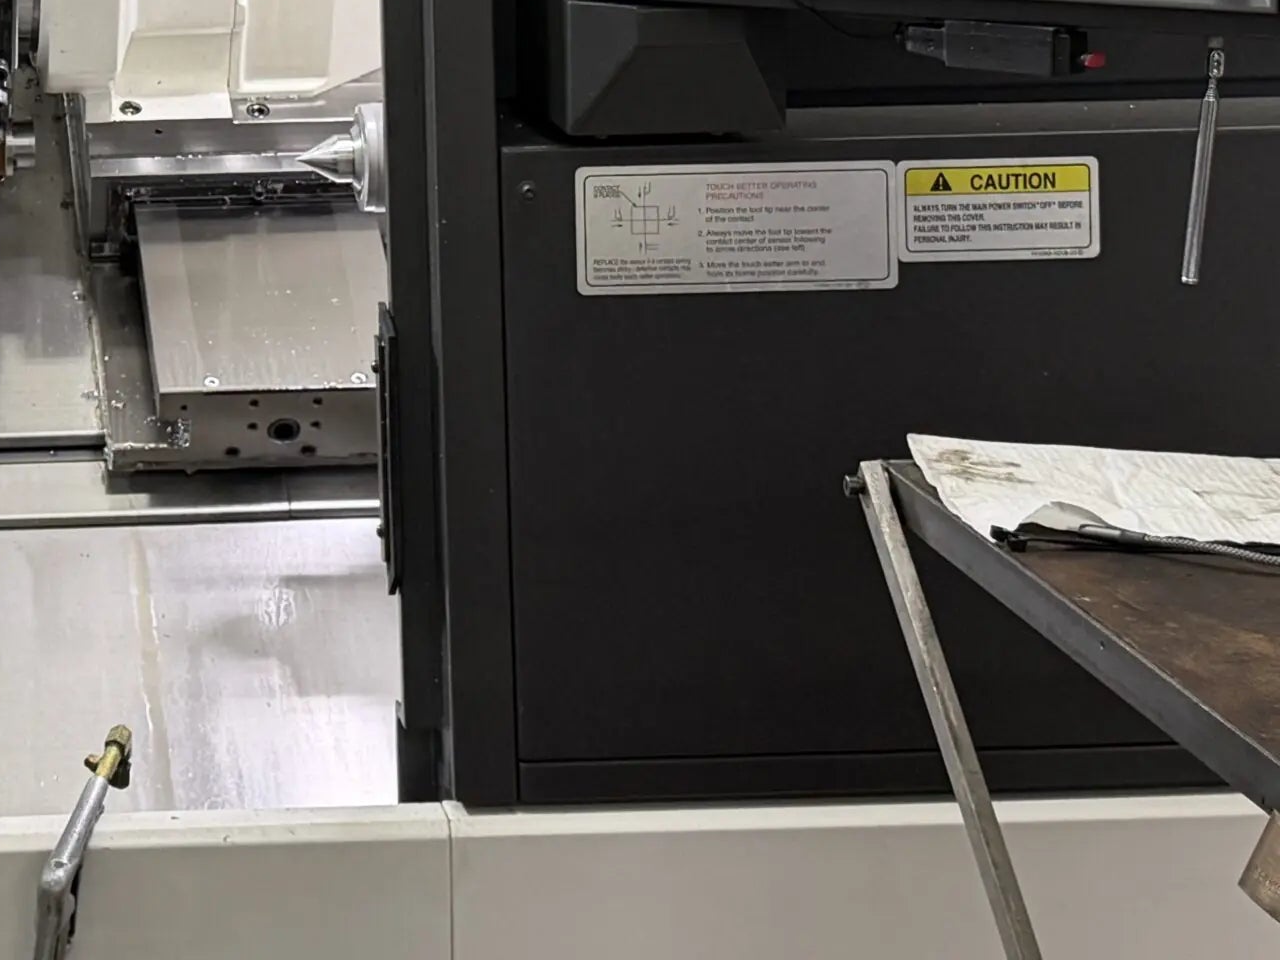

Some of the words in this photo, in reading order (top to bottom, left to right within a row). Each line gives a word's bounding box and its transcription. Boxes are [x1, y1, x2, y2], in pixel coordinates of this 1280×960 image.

[770, 181, 817, 189] OPERATING
[971, 172, 1056, 190] CAUTION
[705, 192, 763, 200] PRECAUTIONS
[972, 203, 987, 211] MAIN
[948, 214, 961, 222] THIS
[941, 224, 949, 232] TO
[993, 223, 1033, 231] INSTRUCTION
[1050, 222, 1072, 230] RESULT
[914, 235, 946, 243] PERSONAL
